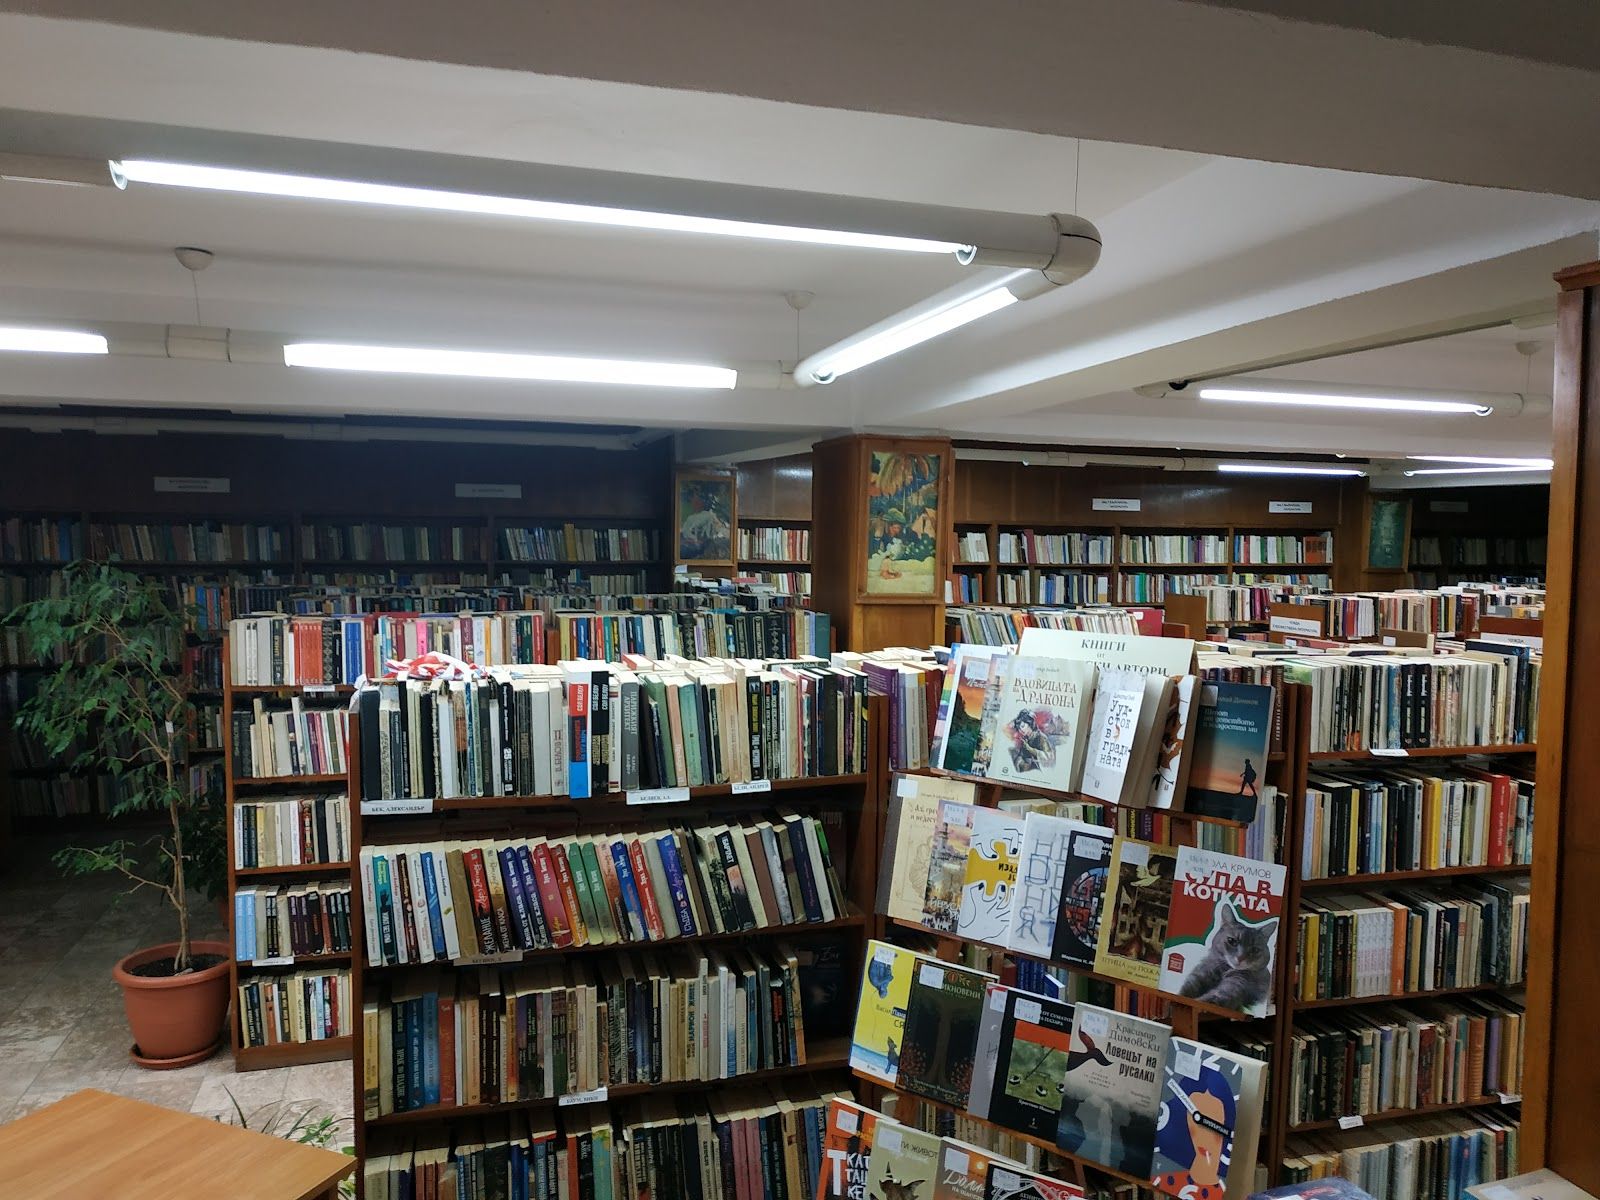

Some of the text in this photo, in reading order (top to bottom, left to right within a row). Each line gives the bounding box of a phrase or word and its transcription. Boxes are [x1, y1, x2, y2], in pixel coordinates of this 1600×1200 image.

[1081, 639, 1126, 652] КНИГИ
[1116, 664, 1170, 677] АВТОРИ
[1014, 677, 1077, 694] ВДОВИЦАТА
[1016, 690, 1076, 708] ДРАКОНА
[630, 691, 639, 735] ПАРИЖКИЯТ
[1100, 754, 1122, 768] ната
[1230, 862, 1272, 879] КРУМОВ
[1183, 881, 1270, 914] КОТКАТА
[1257, 880, 1272, 895] В
[681, 907, 693, 931] СЪДБА
[481, 916, 496, 956] ЖЕЛАНИЕ
[1109, 1031, 1160, 1052] Димовски
[1115, 1022, 1157, 1042] Красимир
[1106, 1042, 1157, 1068] Ловецът на
[1119, 1062, 1155, 1084] русалки
[911, 1143, 938, 1158] ЖИВОТ
[827, 1150, 849, 1196] Т
